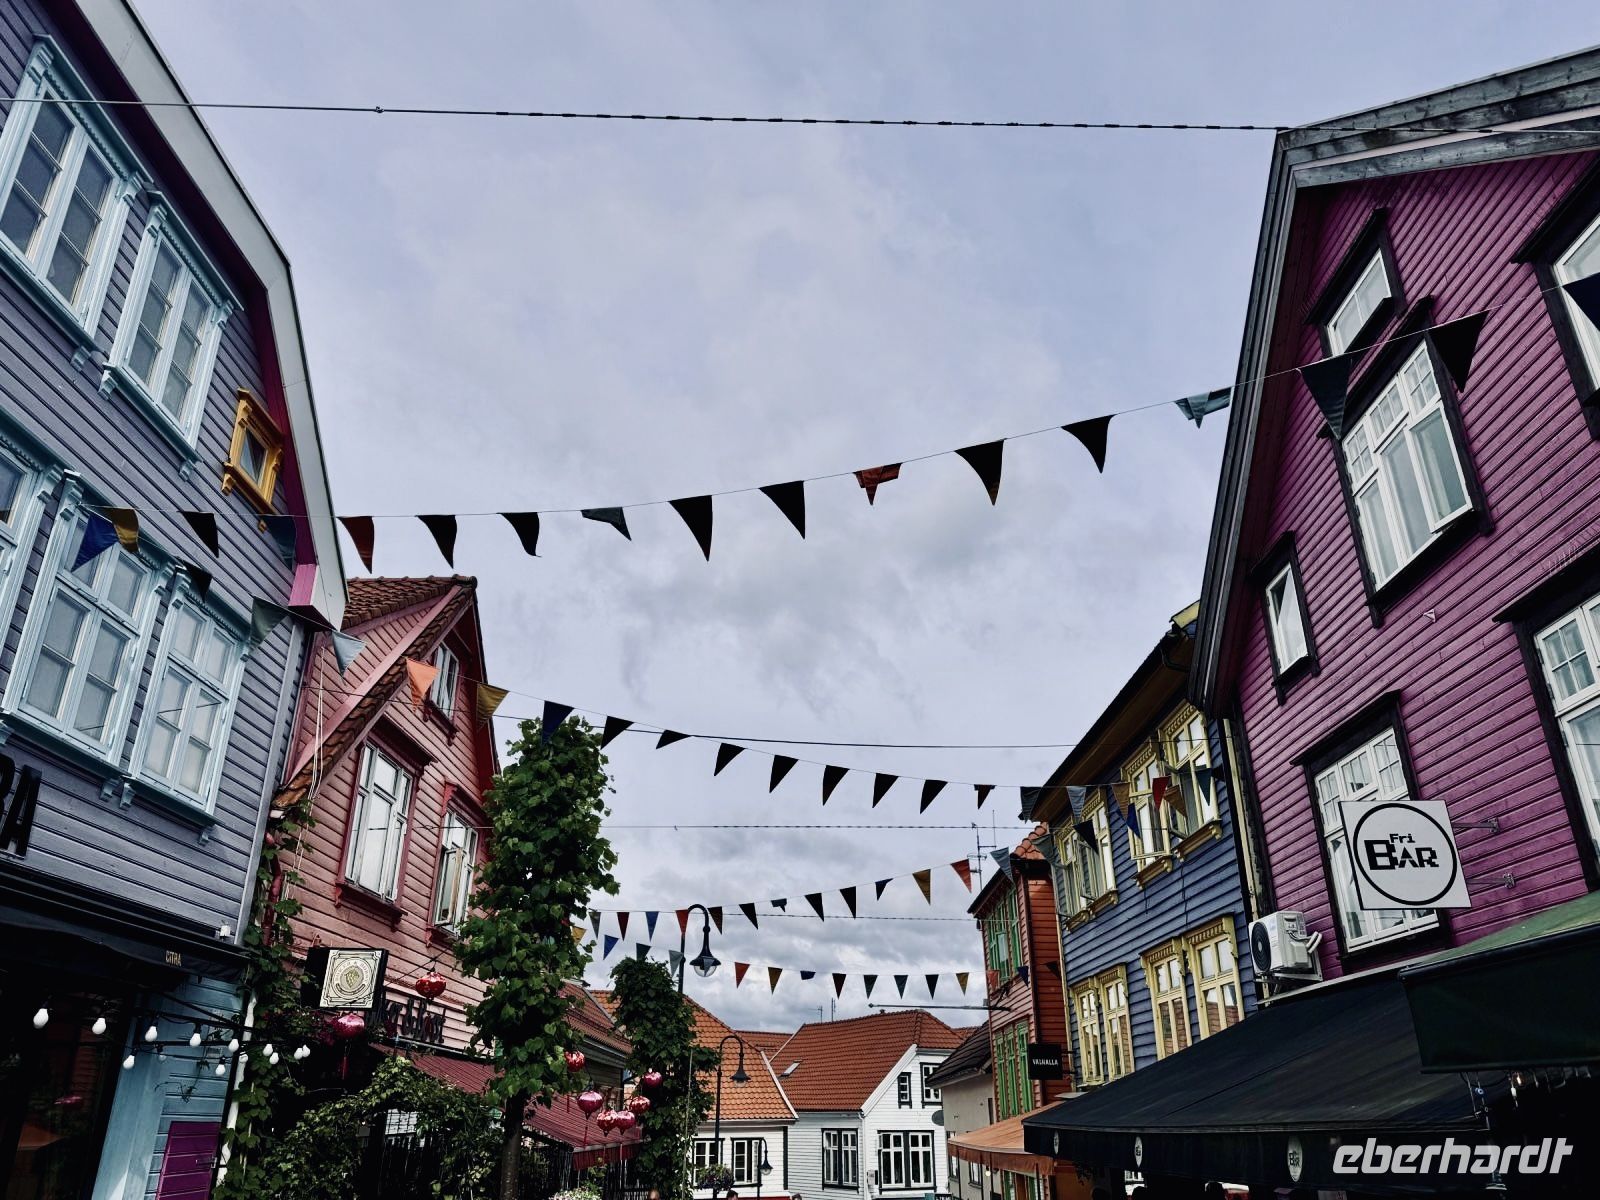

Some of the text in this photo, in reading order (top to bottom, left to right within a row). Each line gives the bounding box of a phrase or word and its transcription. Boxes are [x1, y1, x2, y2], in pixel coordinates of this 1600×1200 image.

[1389, 833, 1416, 844] Fri
[1364, 839, 1439, 870] BAR
[1032, 1058, 1059, 1066] VALHALLA
